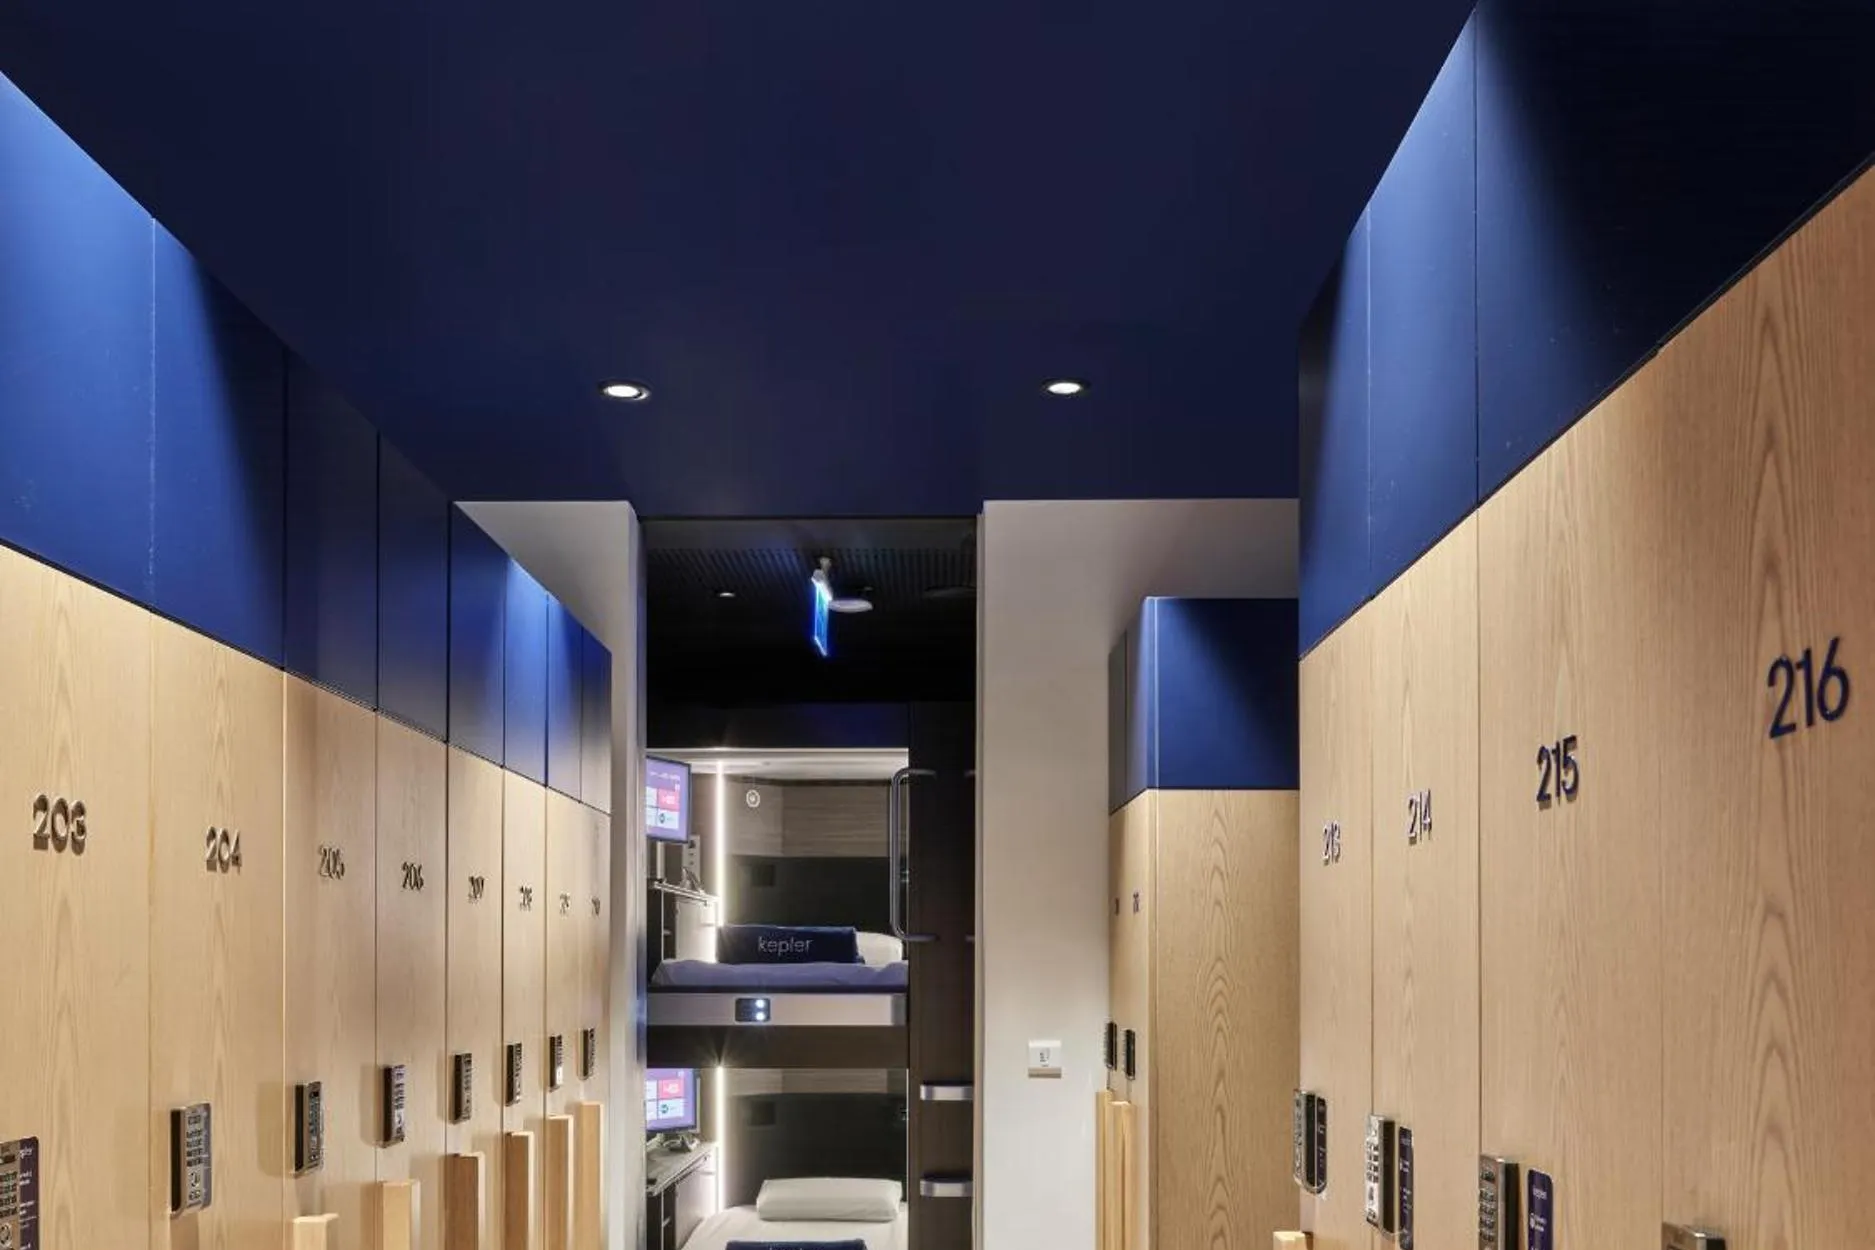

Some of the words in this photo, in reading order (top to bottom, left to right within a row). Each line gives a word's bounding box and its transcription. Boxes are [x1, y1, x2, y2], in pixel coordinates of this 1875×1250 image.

[1768, 637, 1850, 739] 216
[1537, 735, 1579, 806] 215
[33, 795, 87, 855] 203
[1408, 789, 1432, 844] 214
[206, 826, 242, 873] 204
[758, 936, 813, 956] kepler
